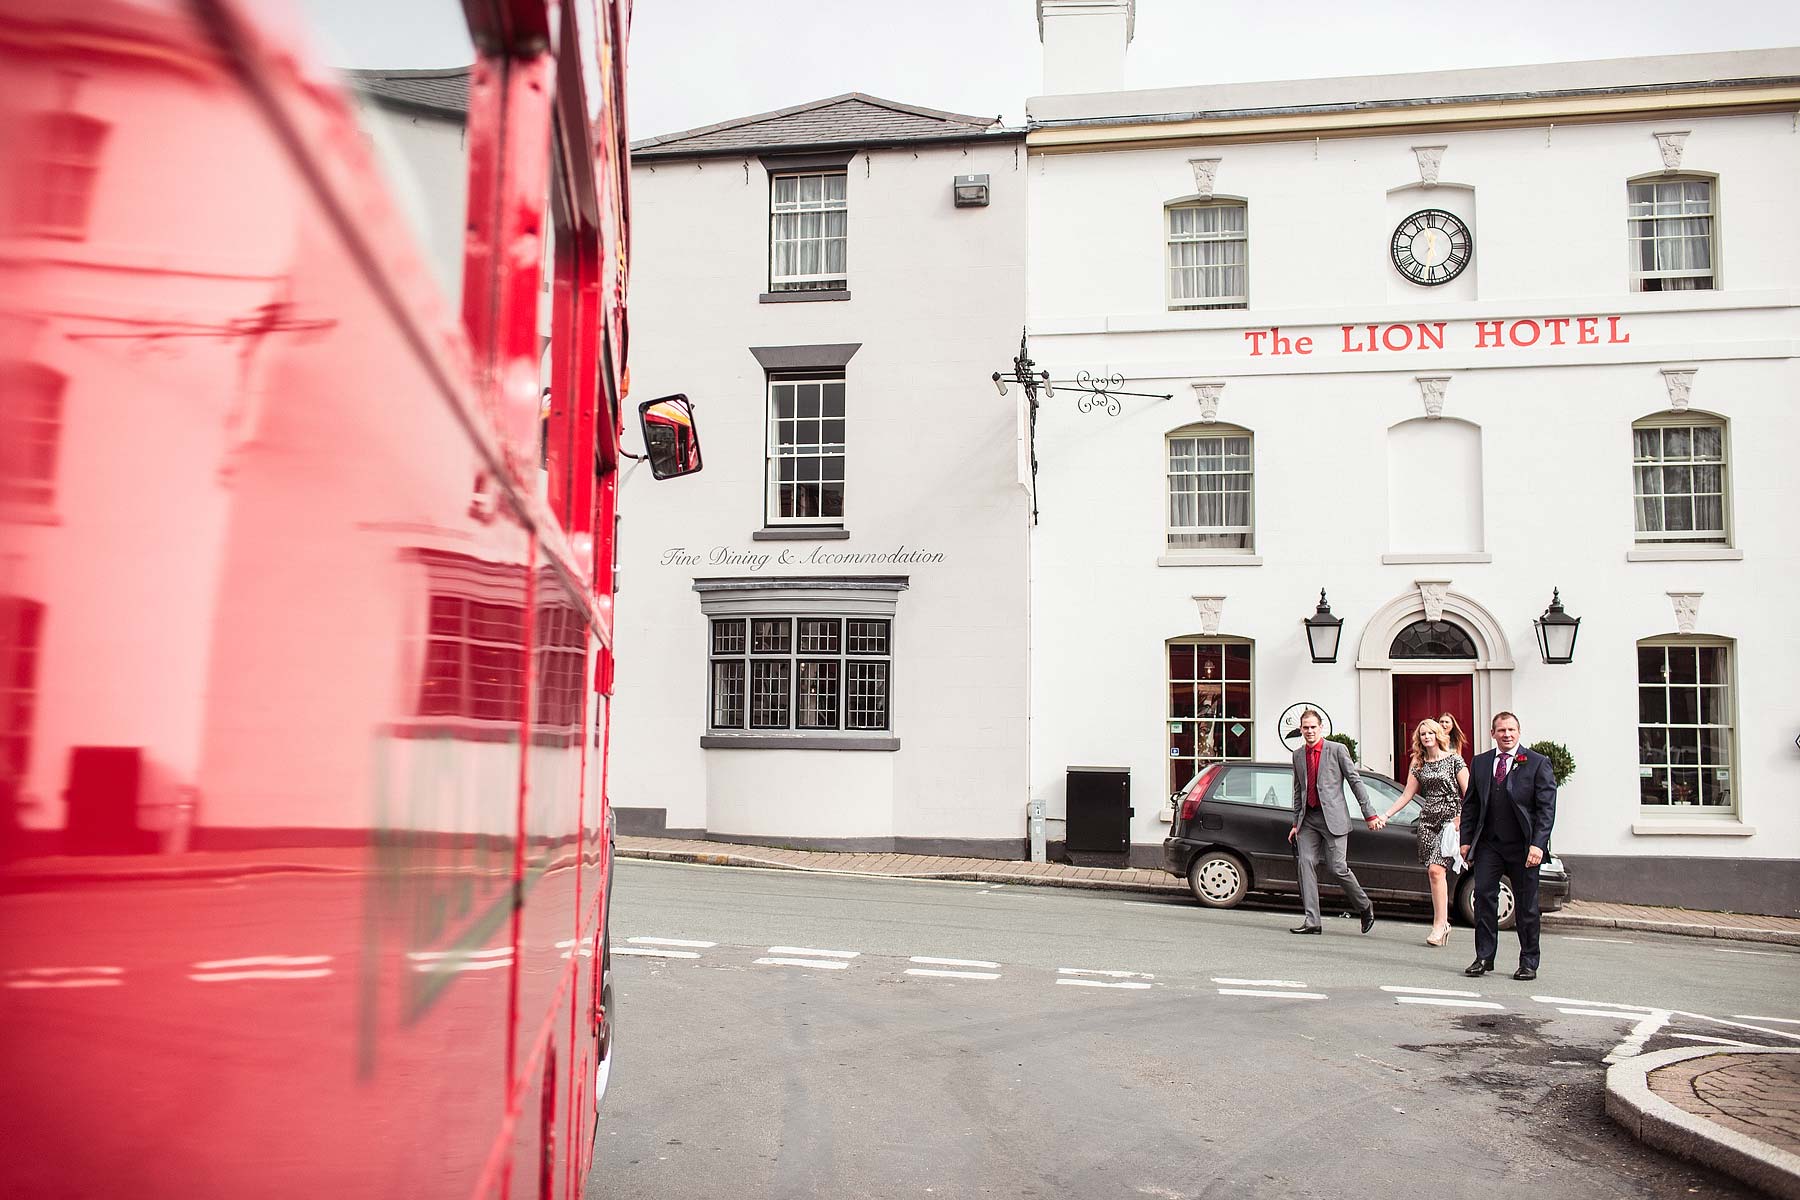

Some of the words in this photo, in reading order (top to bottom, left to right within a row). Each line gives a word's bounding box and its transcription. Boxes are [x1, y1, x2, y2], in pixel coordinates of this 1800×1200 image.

[1245, 327, 1313, 356] The
[1342, 322, 1448, 353] LION
[1475, 316, 1630, 348] HOTEL
[660, 547, 702, 566] Fine
[708, 545, 772, 572] Dining
[777, 548, 795, 565] &
[799, 545, 946, 566] Accommodation
